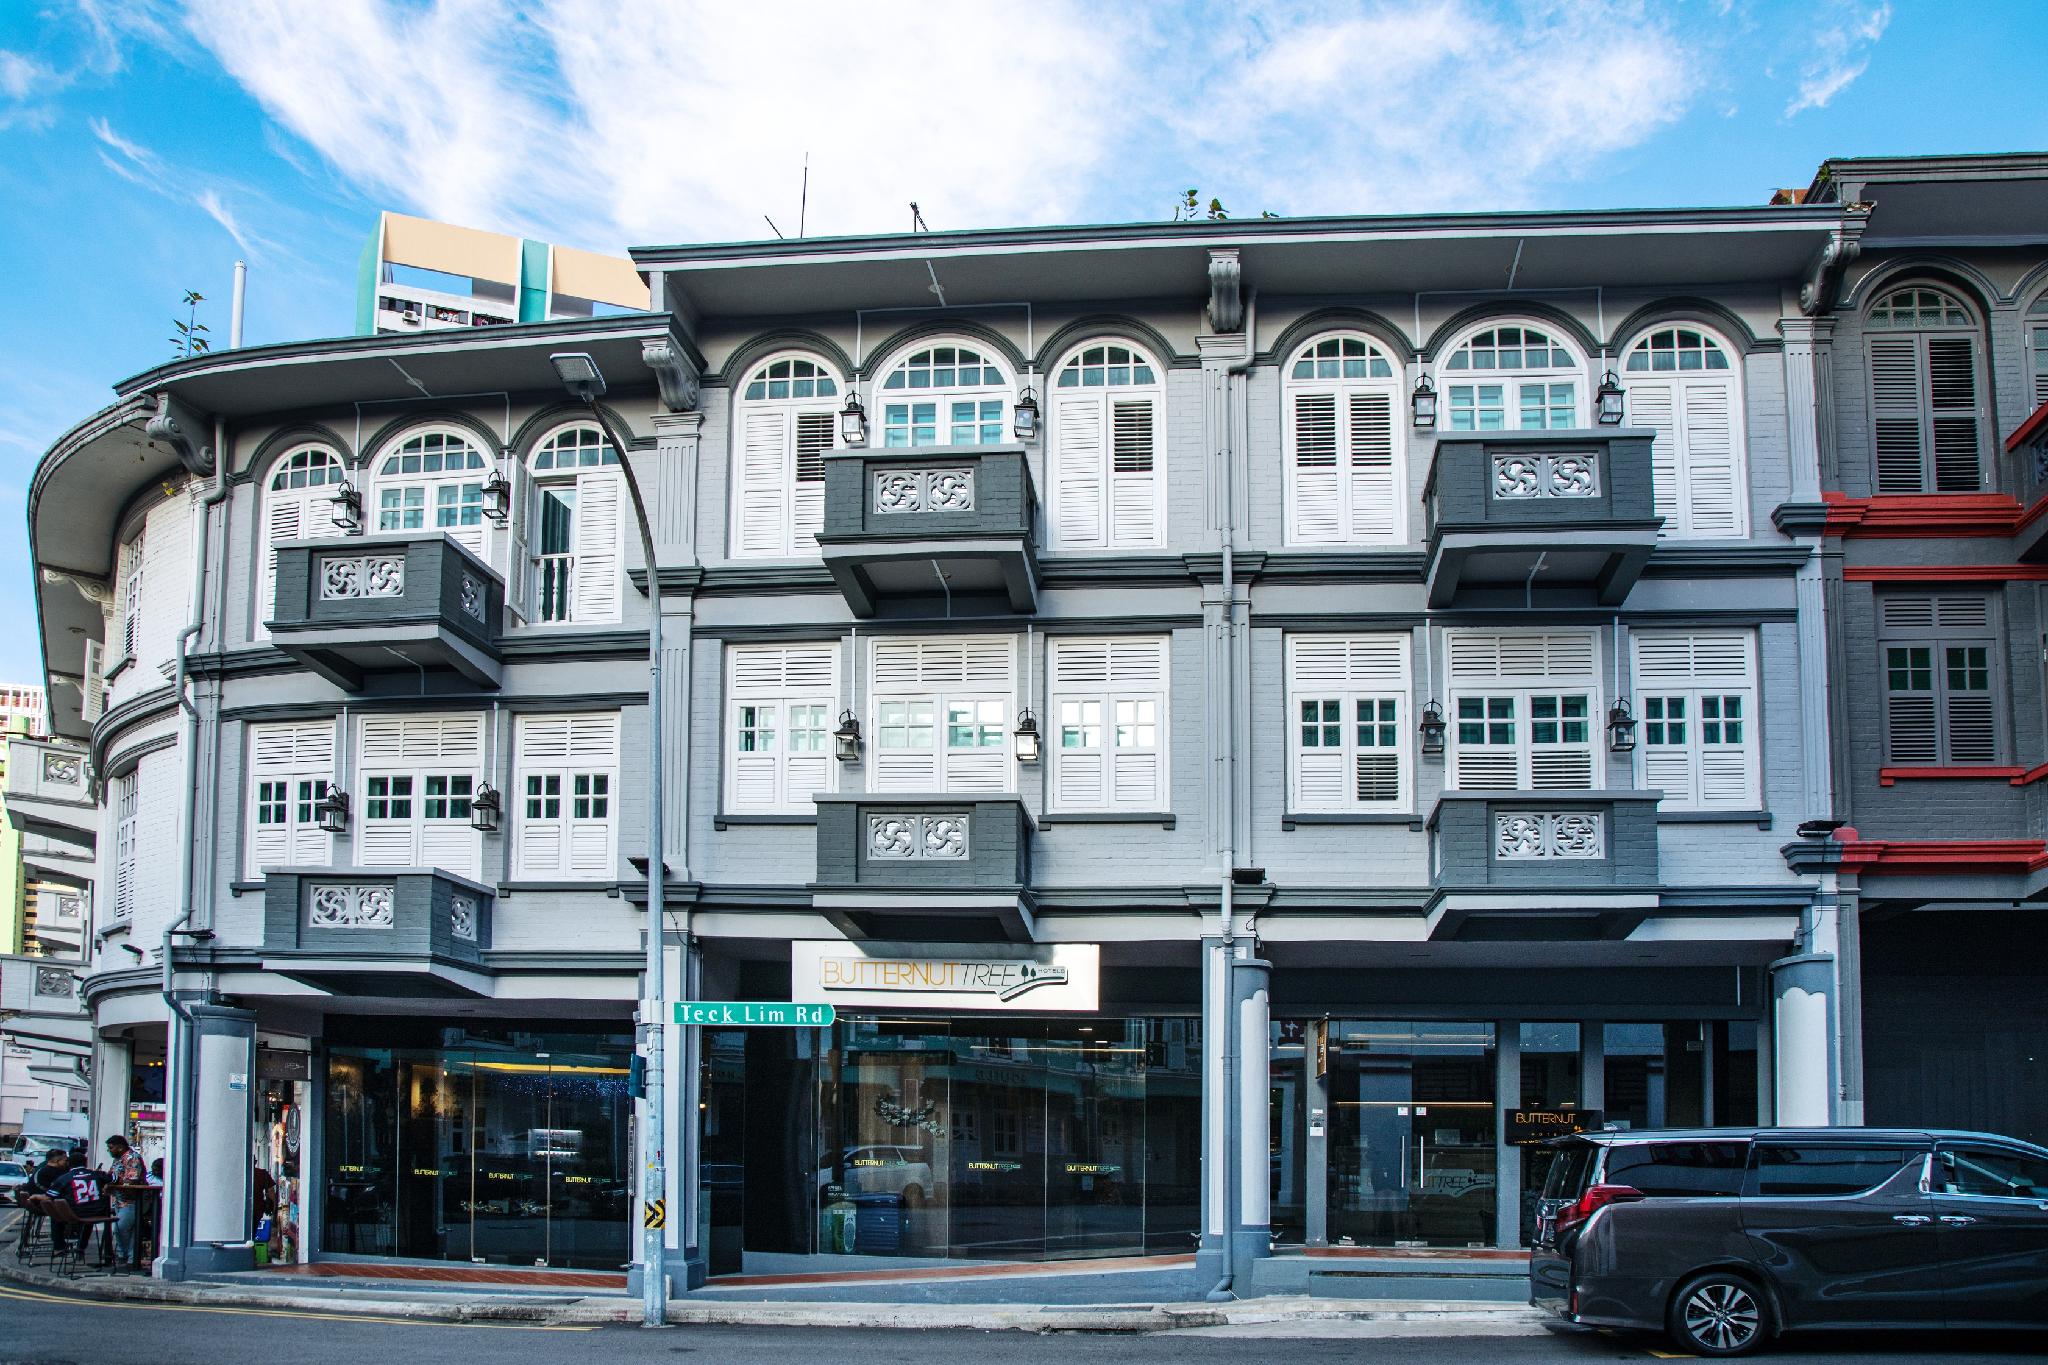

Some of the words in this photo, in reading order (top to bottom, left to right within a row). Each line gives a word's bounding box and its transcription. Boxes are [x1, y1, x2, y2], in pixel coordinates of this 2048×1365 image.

[823, 961, 960, 986] BUTTERNUT
[960, 963, 1018, 987] TREE
[680, 1004, 734, 1022] Teck
[745, 1005, 784, 1022] Lim
[796, 1006, 823, 1023] Rd
[1515, 1112, 1576, 1124] BUTTERNUT
[854, 1159, 884, 1167] BUTTERNUT
[968, 1162, 998, 1170] BUTTERNUT
[414, 1168, 439, 1176] BUTTERNUT
[1067, 1164, 1097, 1172] BUTTERNUT
[488, 1172, 514, 1180] BUTTERNUT
[565, 1176, 591, 1184] BUTTERNUT
[73, 1179, 100, 1203] 24
